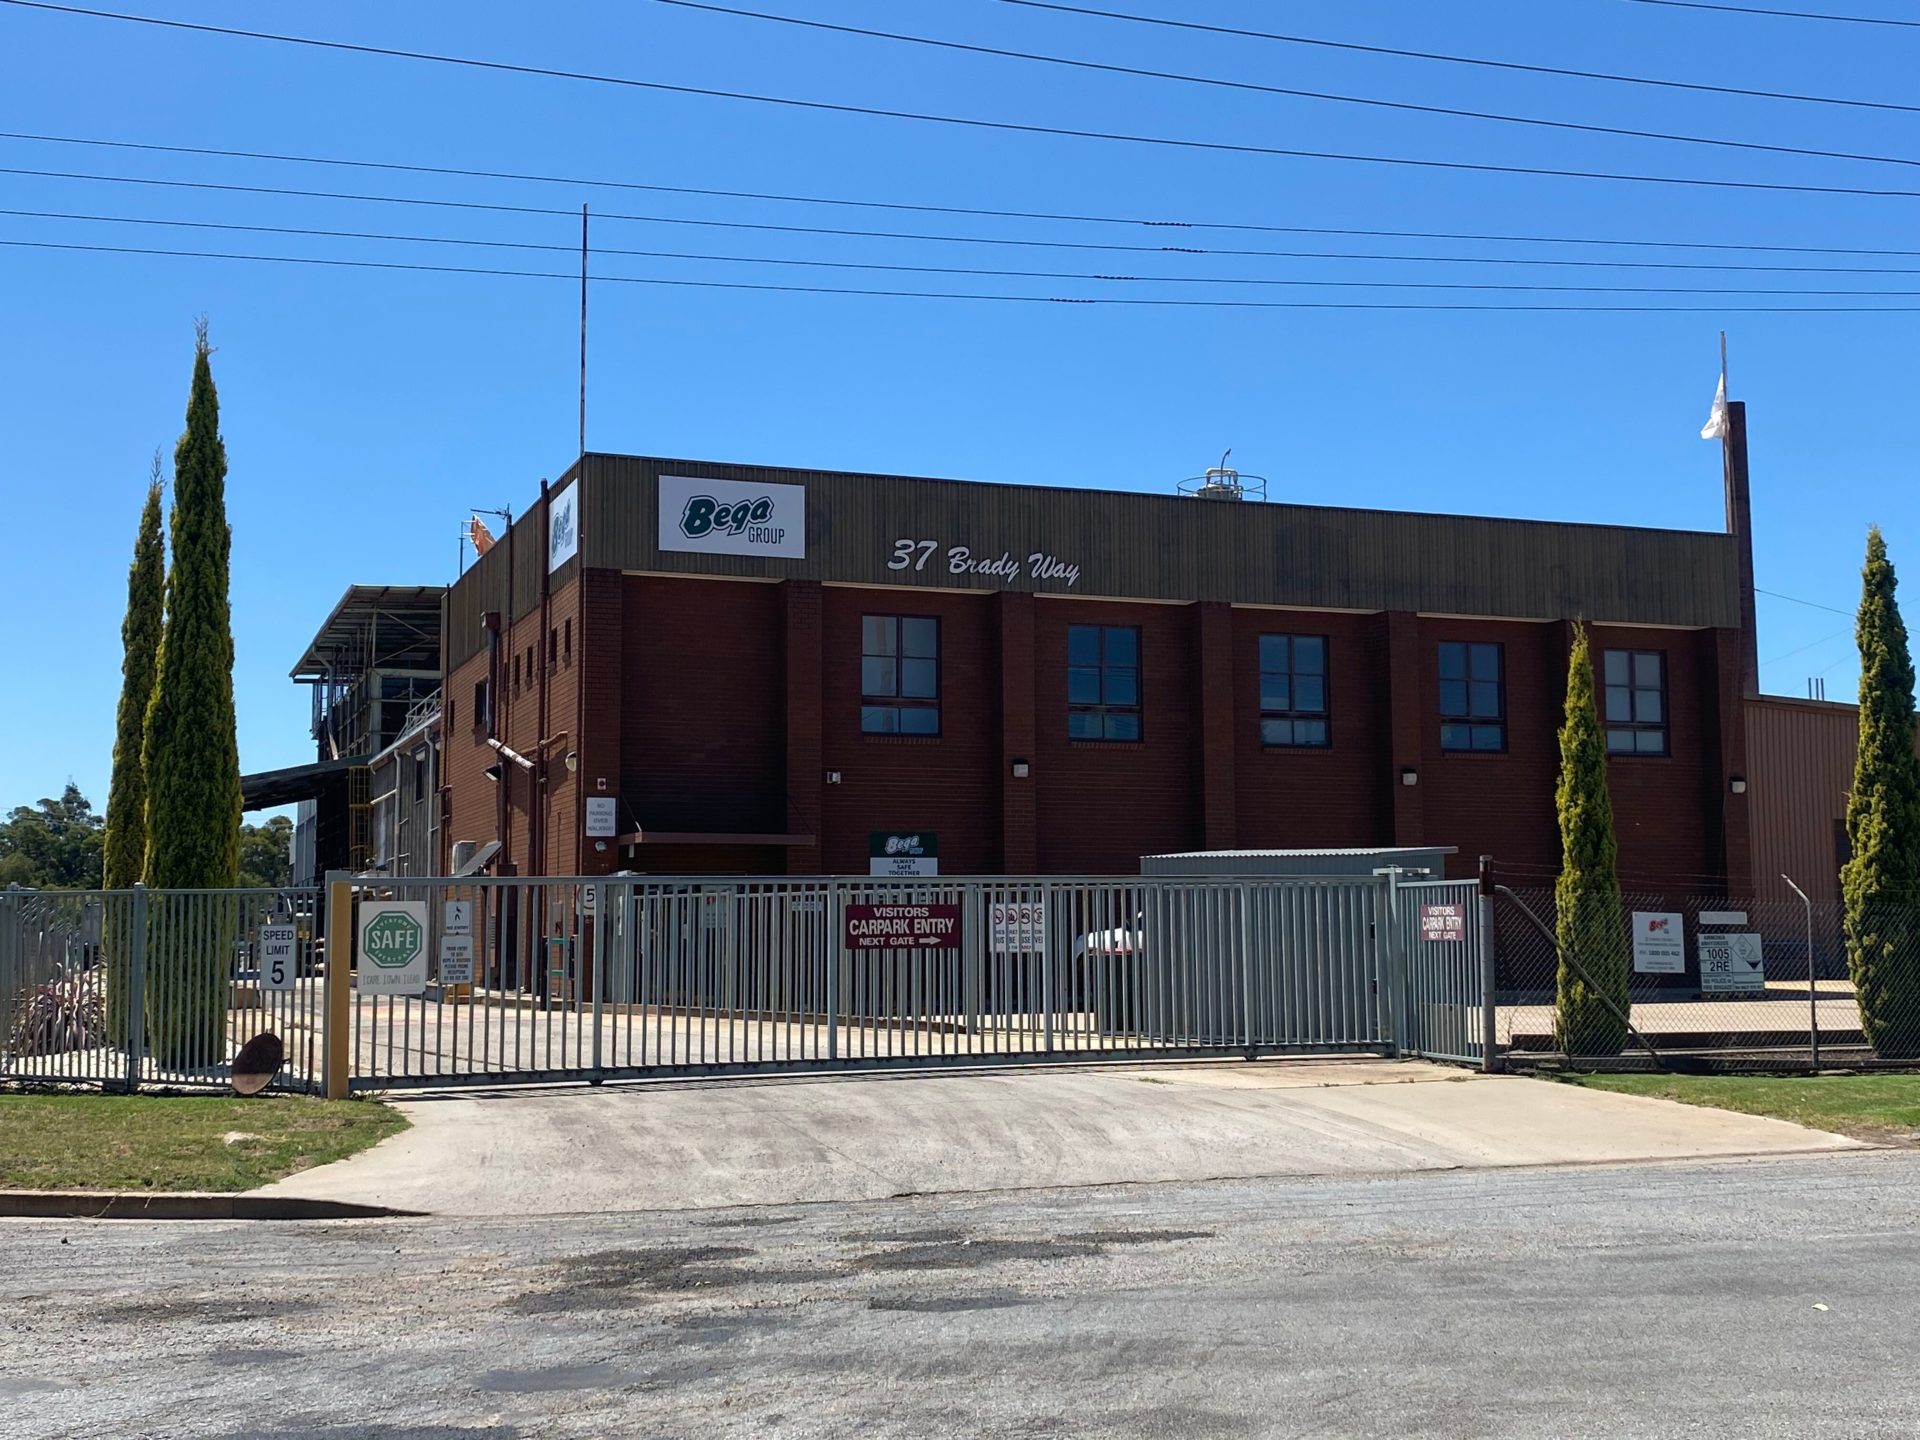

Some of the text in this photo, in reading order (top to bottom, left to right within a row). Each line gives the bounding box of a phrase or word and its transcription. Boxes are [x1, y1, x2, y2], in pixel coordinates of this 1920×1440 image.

[679, 495, 774, 538] Bega
[748, 527, 784, 544] GROUP
[887, 539, 1080, 587] 37 Brady Way
[885, 835, 920, 854] Bega
[586, 888, 595, 903] 5
[873, 907, 929, 917] VISITORS
[1428, 906, 1455, 916] VISITORS
[849, 918, 954, 935] CARPARK ENTRY
[1422, 916, 1462, 931] CARPARK ENTRY
[263, 930, 294, 940] SPEED
[371, 930, 415, 949] SAFE
[859, 937, 915, 946] NEXT GATE
[1428, 931, 1457, 940] NEXT GATE
[266, 945, 290, 955] LIMIT
[1707, 948, 1730, 959] 1005
[271, 960, 284, 985] 5
[1710, 961, 1730, 972] 2RE
